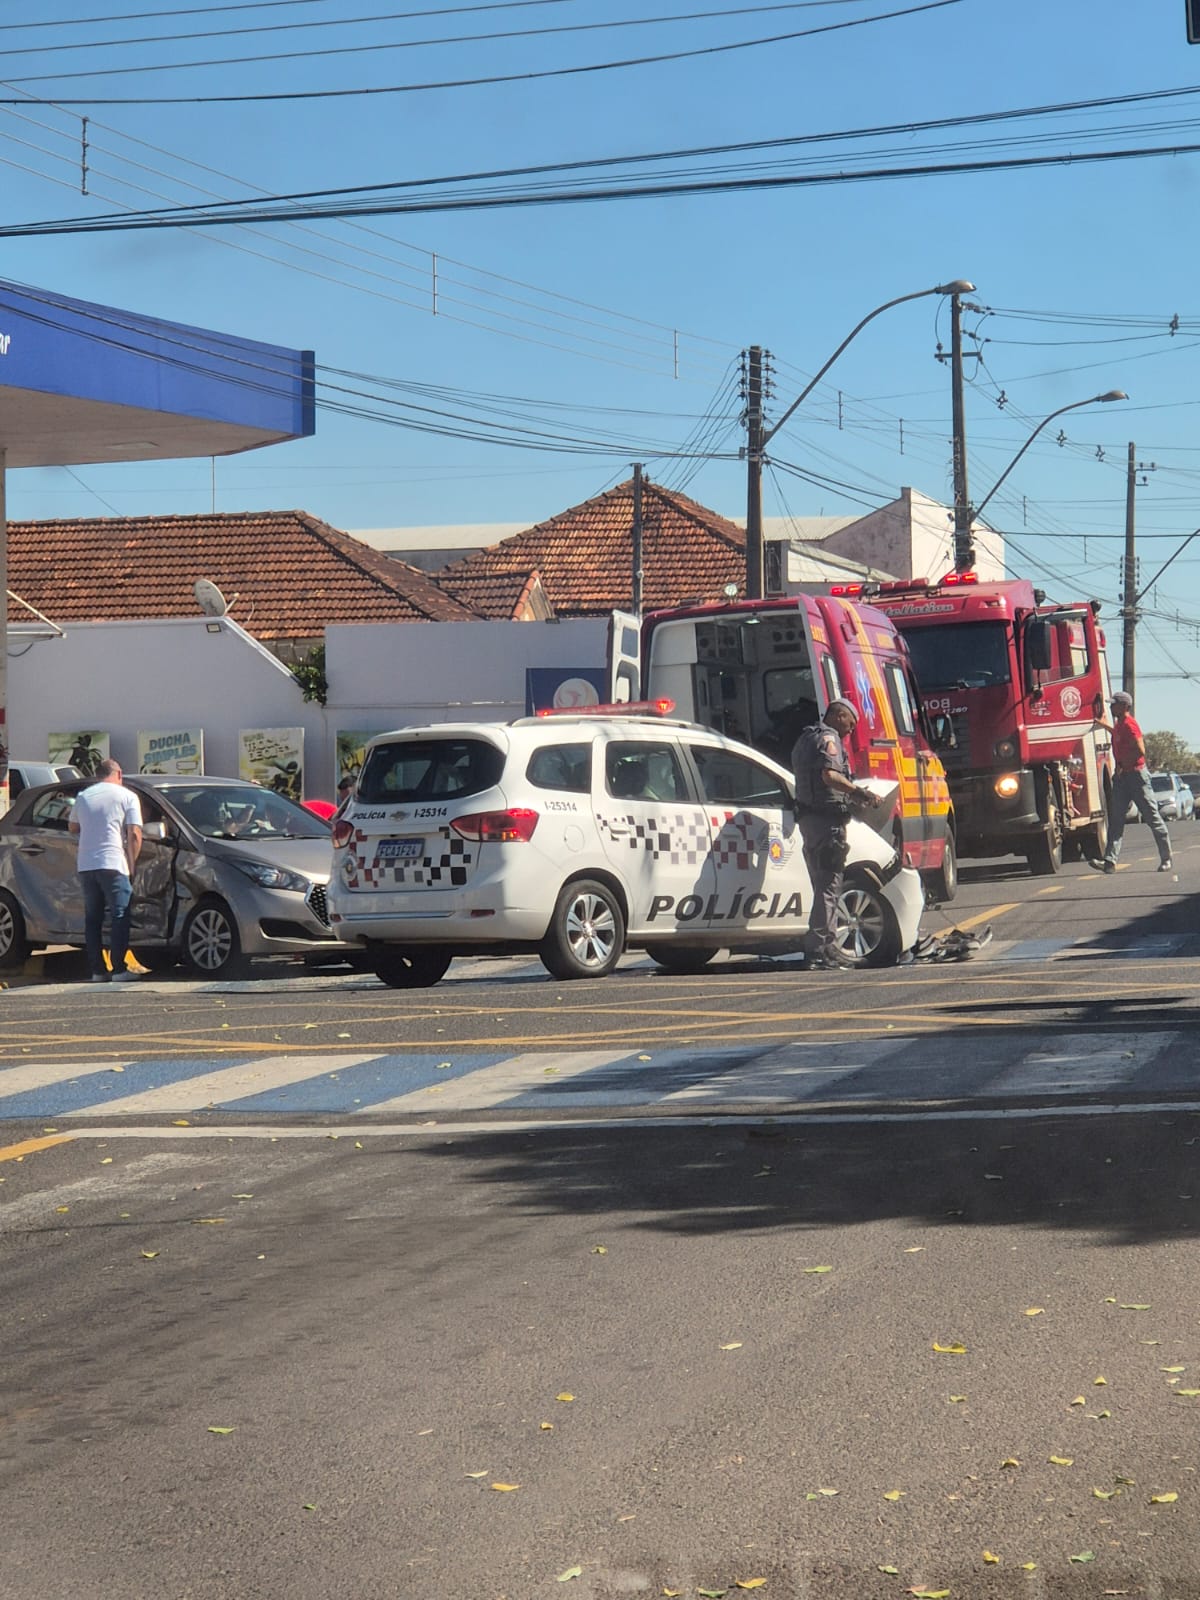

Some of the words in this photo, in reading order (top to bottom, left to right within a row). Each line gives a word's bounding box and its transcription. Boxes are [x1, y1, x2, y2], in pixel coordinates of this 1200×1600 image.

[149, 732, 191, 751] DUCHA
[144, 745, 197, 765] SIMPLES
[352, 810, 386, 820] POLÍCIA
[414, 807, 448, 818] I-25314
[544, 800, 577, 811] I-25314
[646, 886, 804, 922] POLÍCIA
